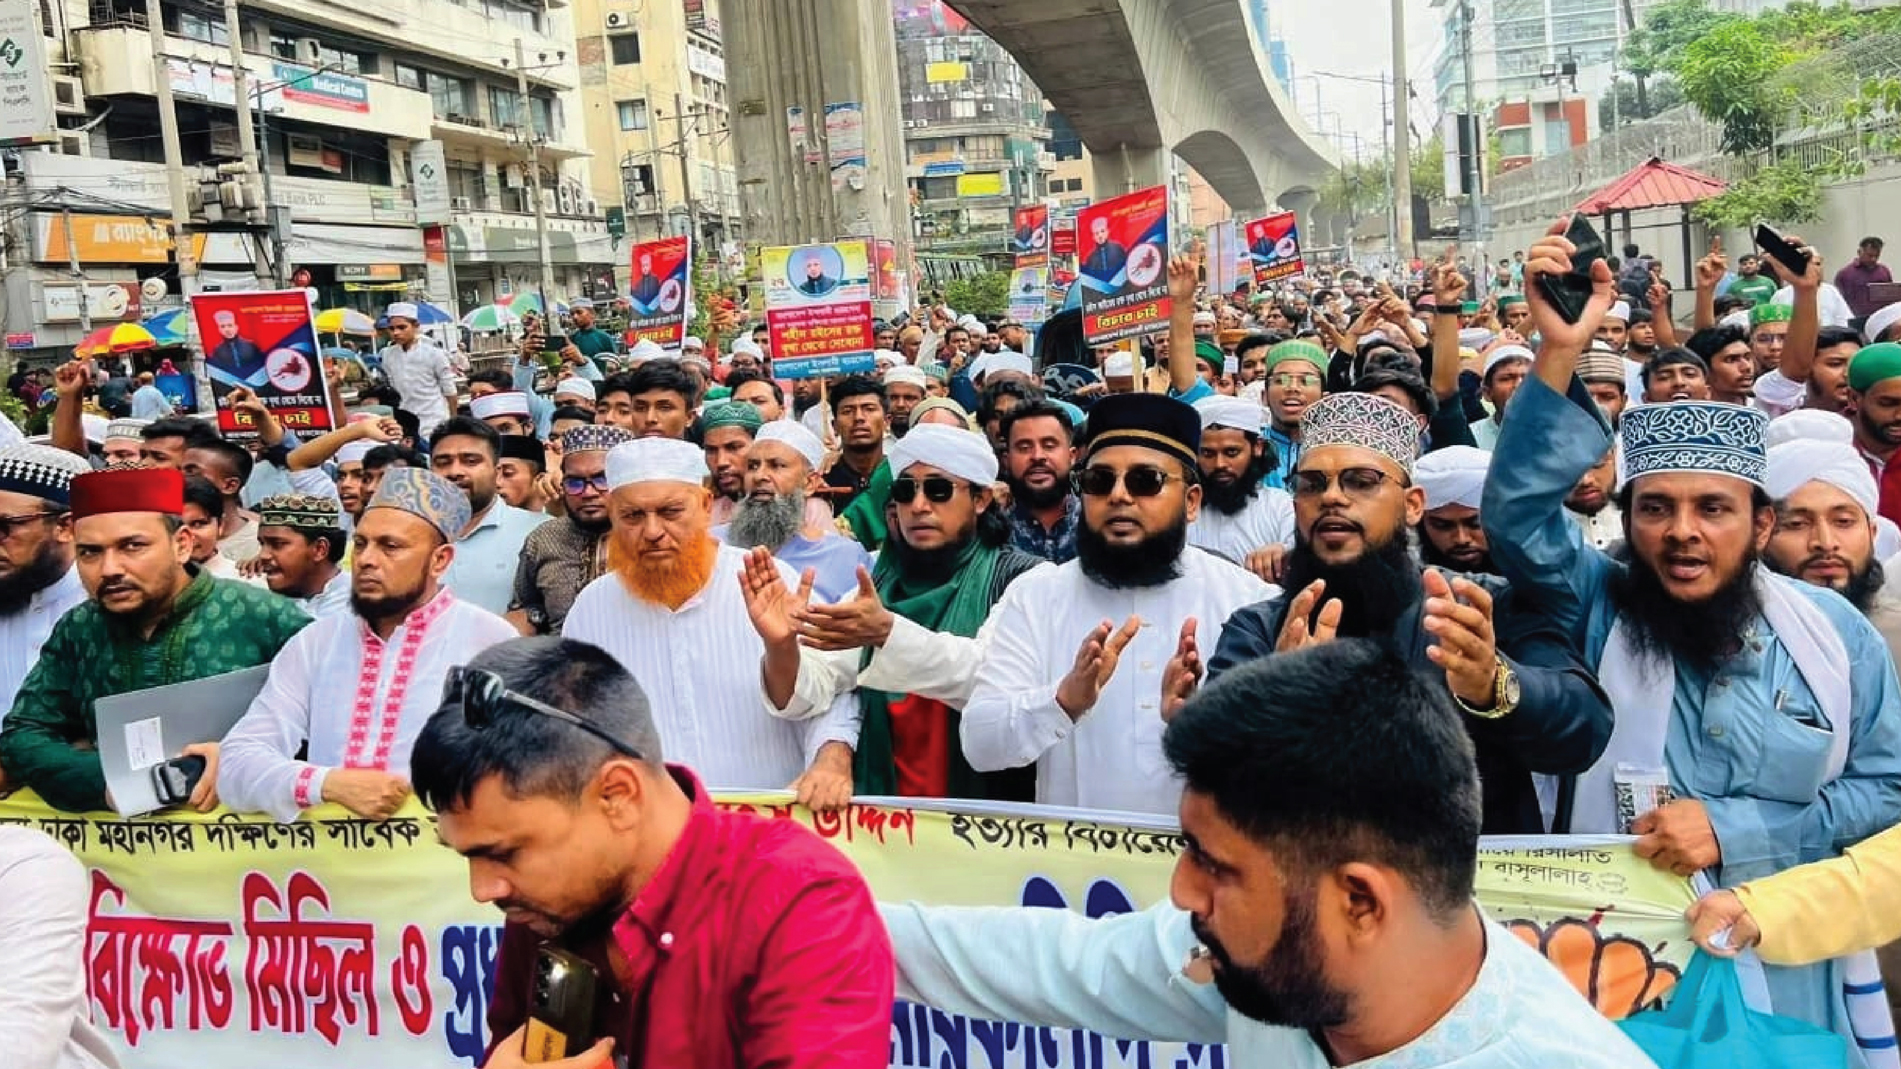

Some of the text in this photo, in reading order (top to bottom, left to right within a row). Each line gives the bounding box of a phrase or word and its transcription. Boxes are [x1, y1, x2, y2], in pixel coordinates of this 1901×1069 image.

[1096, 303, 1158, 329] বিচার চাই
[284, 410, 312, 425] চাই
[95, 818, 195, 855] মহানগর
[206, 812, 315, 851] দক্ষিণের
[318, 816, 420, 850] সাবেক
[946, 810, 1048, 850] হত্যার
[84, 868, 236, 1047] বিক্ষোভ
[242, 870, 378, 1047] মিছিল
[391, 924, 434, 1037] ও
